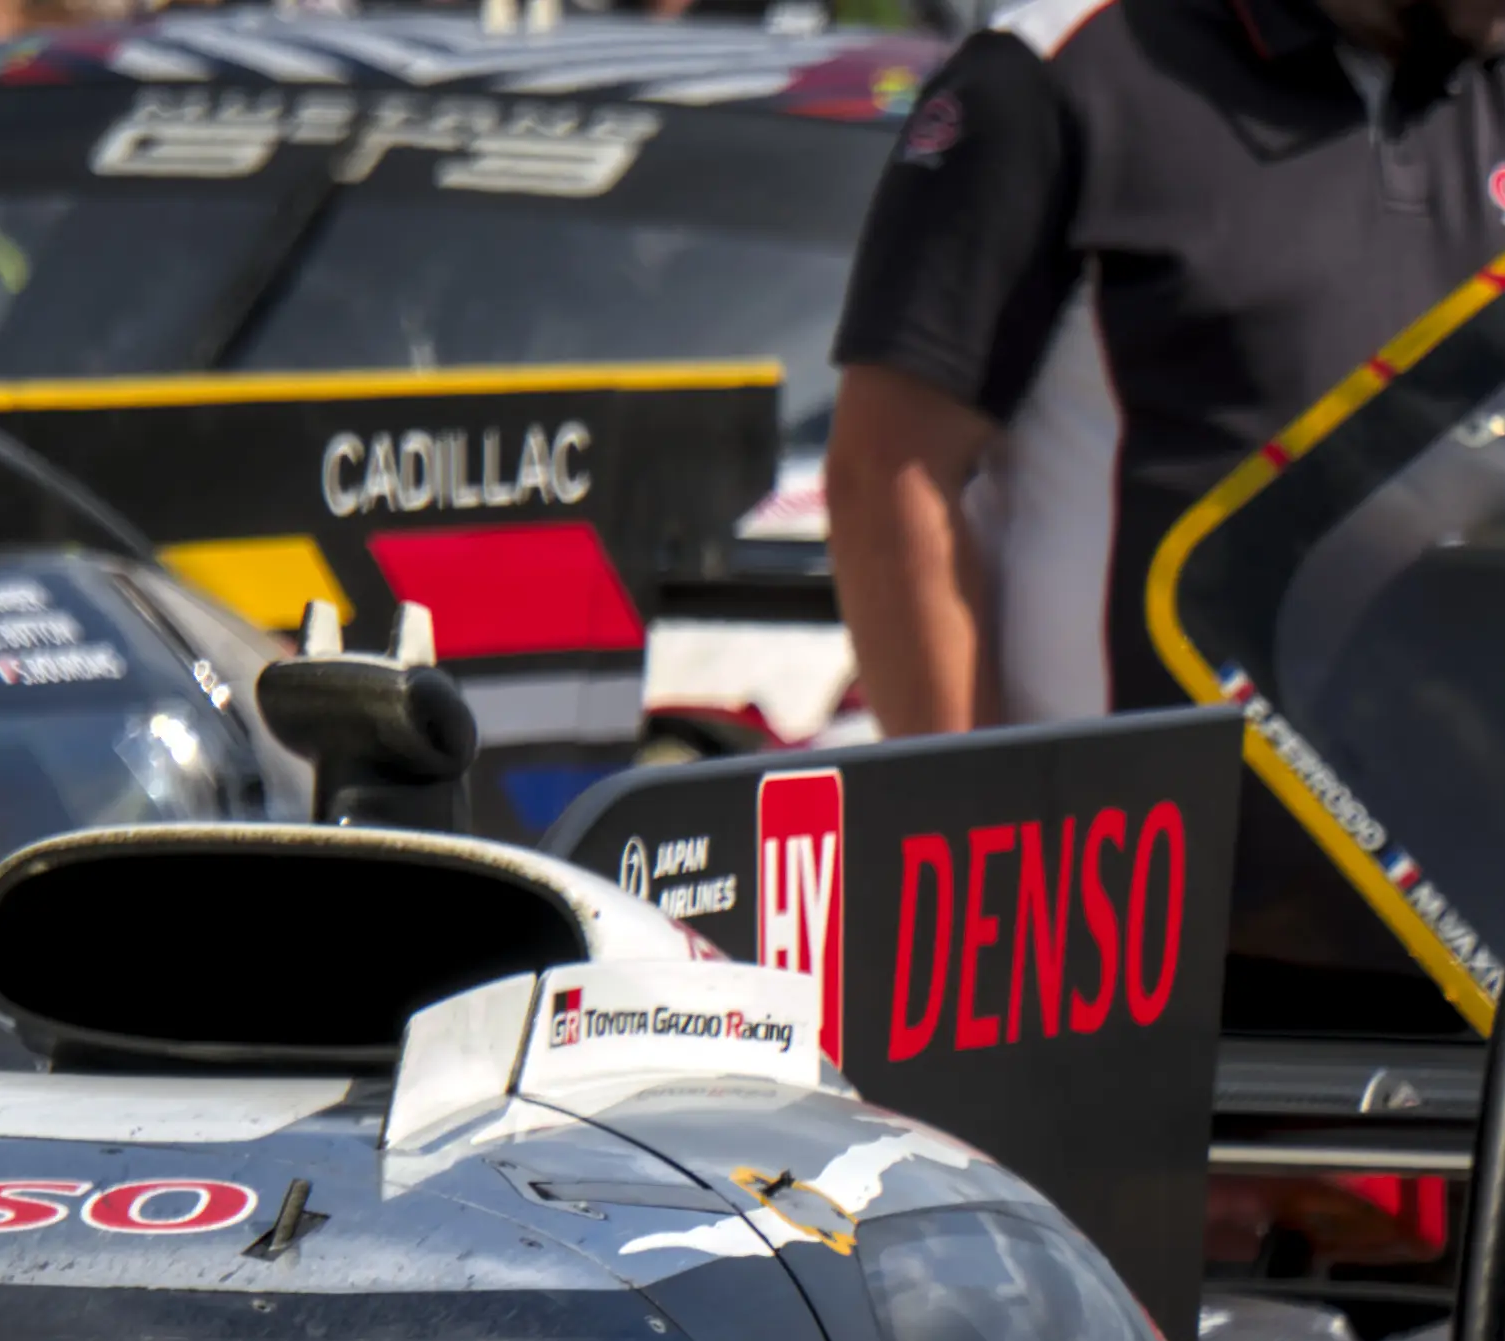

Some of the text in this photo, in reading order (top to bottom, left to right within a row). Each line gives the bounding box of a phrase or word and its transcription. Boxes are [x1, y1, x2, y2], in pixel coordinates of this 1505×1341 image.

[323, 420, 591, 516] CADILLAC
[653, 836, 710, 879] JAPAN
[658, 873, 737, 919] AIRLINES
[888, 800, 1186, 1063] DENSO
[549, 1005, 794, 1053] GR TOYOTA GAZOO Racing
